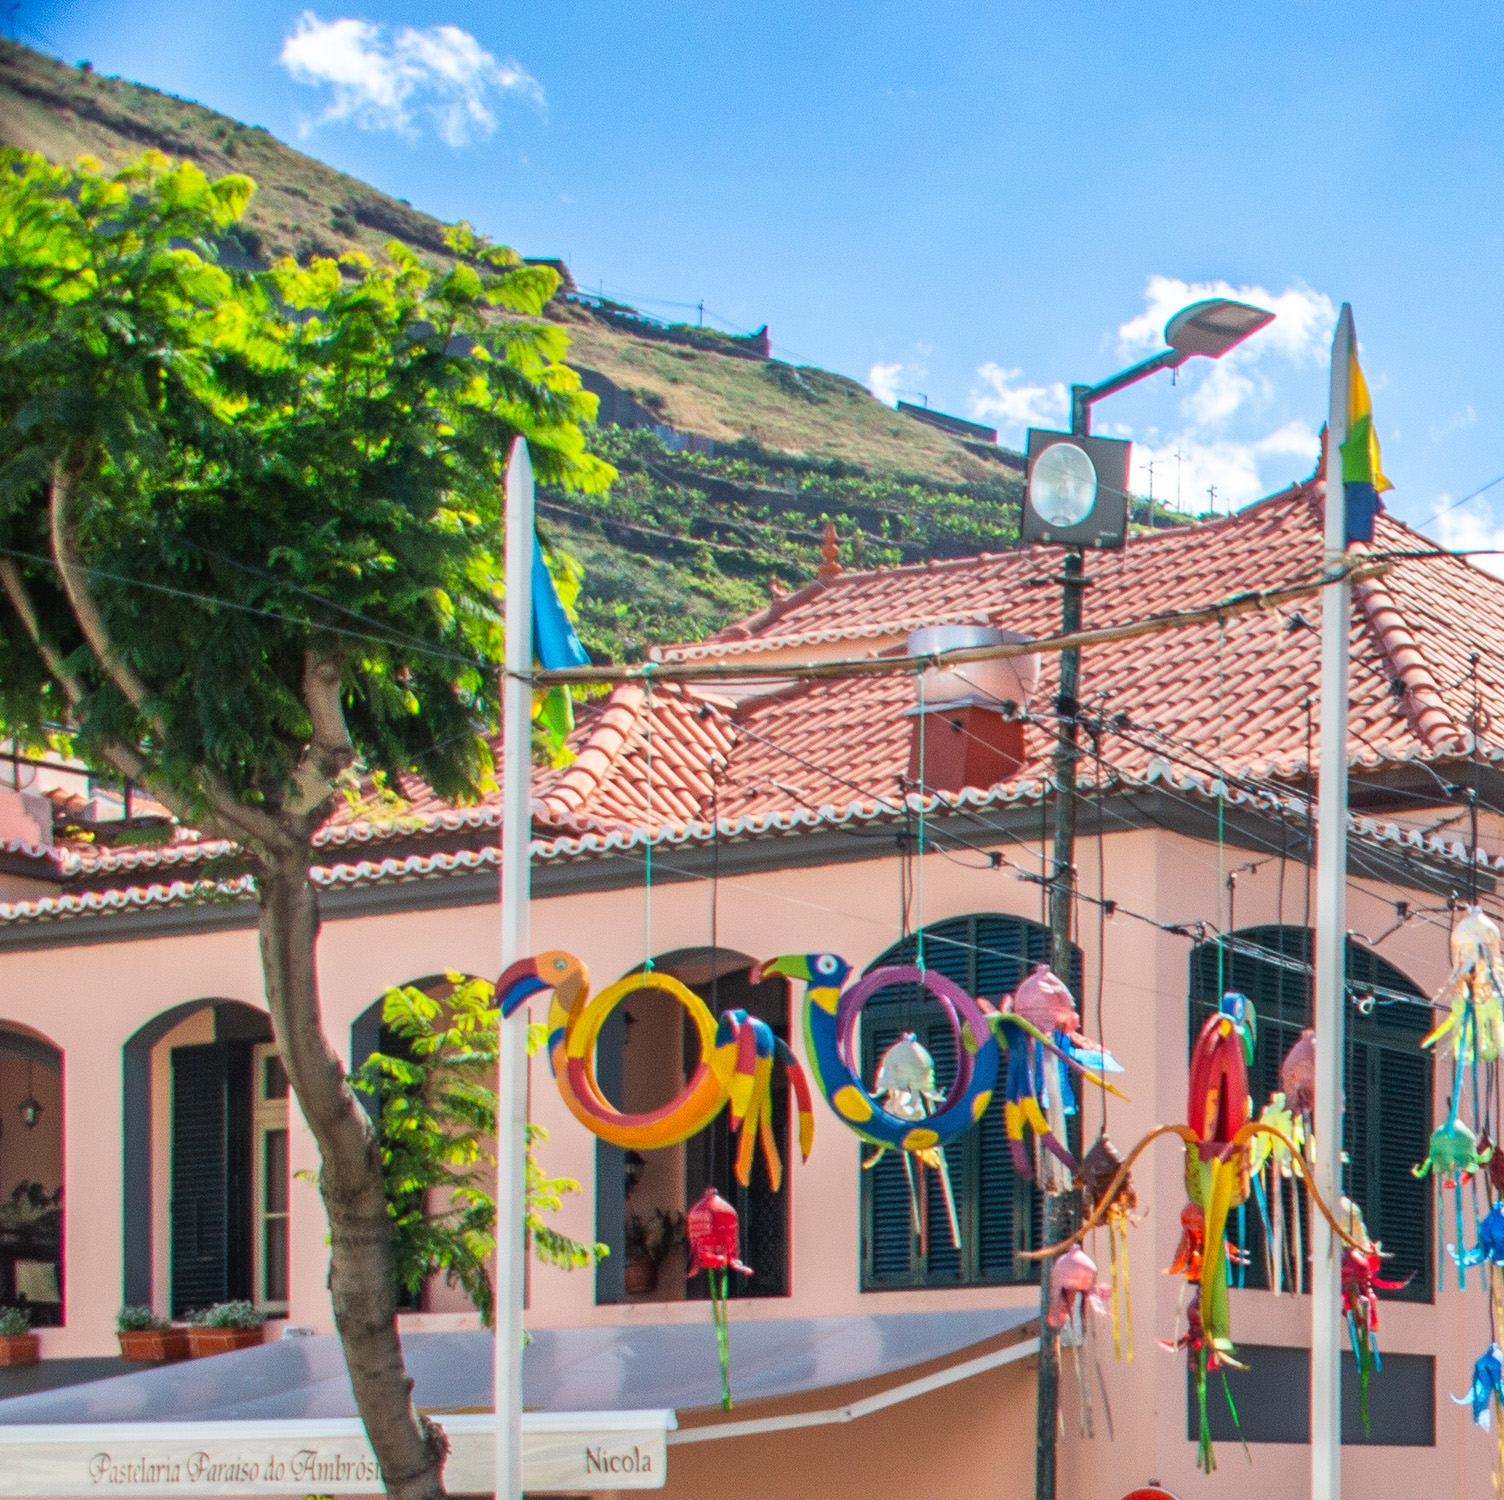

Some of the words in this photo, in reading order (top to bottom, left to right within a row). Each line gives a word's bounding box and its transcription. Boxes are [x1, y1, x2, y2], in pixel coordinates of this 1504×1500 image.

[88, 1451, 181, 1485] Pastelaria
[264, 1455, 286, 1482] do
[290, 1449, 381, 1482] Ambrósi
[585, 1446, 652, 1473] Nicola
